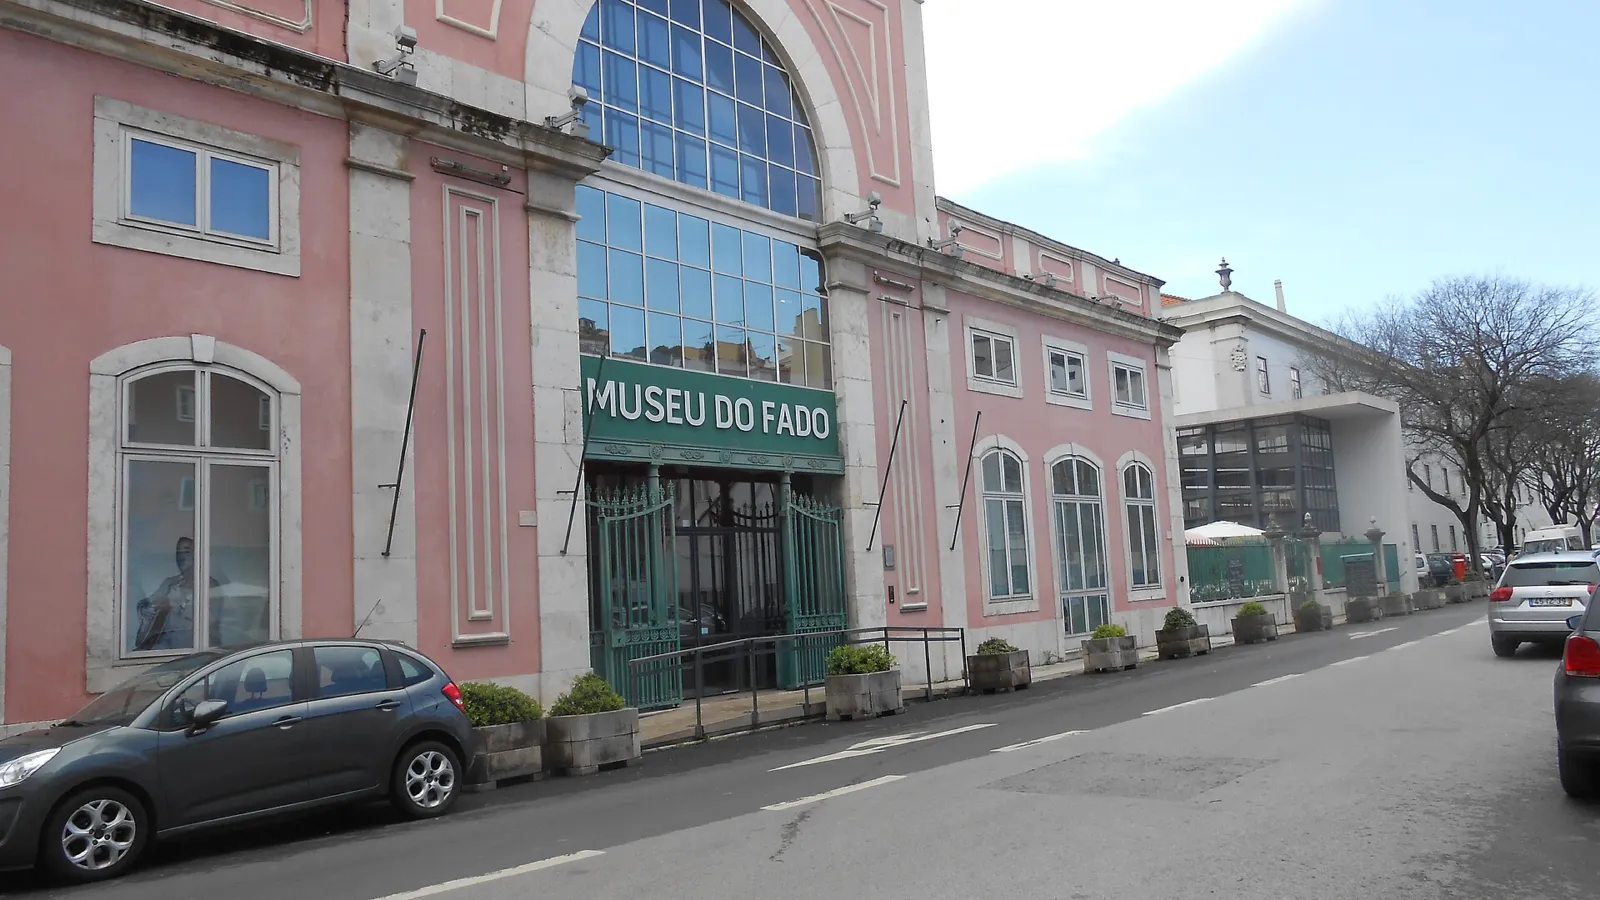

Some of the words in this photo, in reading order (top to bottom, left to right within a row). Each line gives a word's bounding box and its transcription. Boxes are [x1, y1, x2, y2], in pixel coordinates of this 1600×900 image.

[587, 377, 706, 426] MUSEU
[715, 394, 754, 431] DO
[762, 400, 829, 439] FADO
